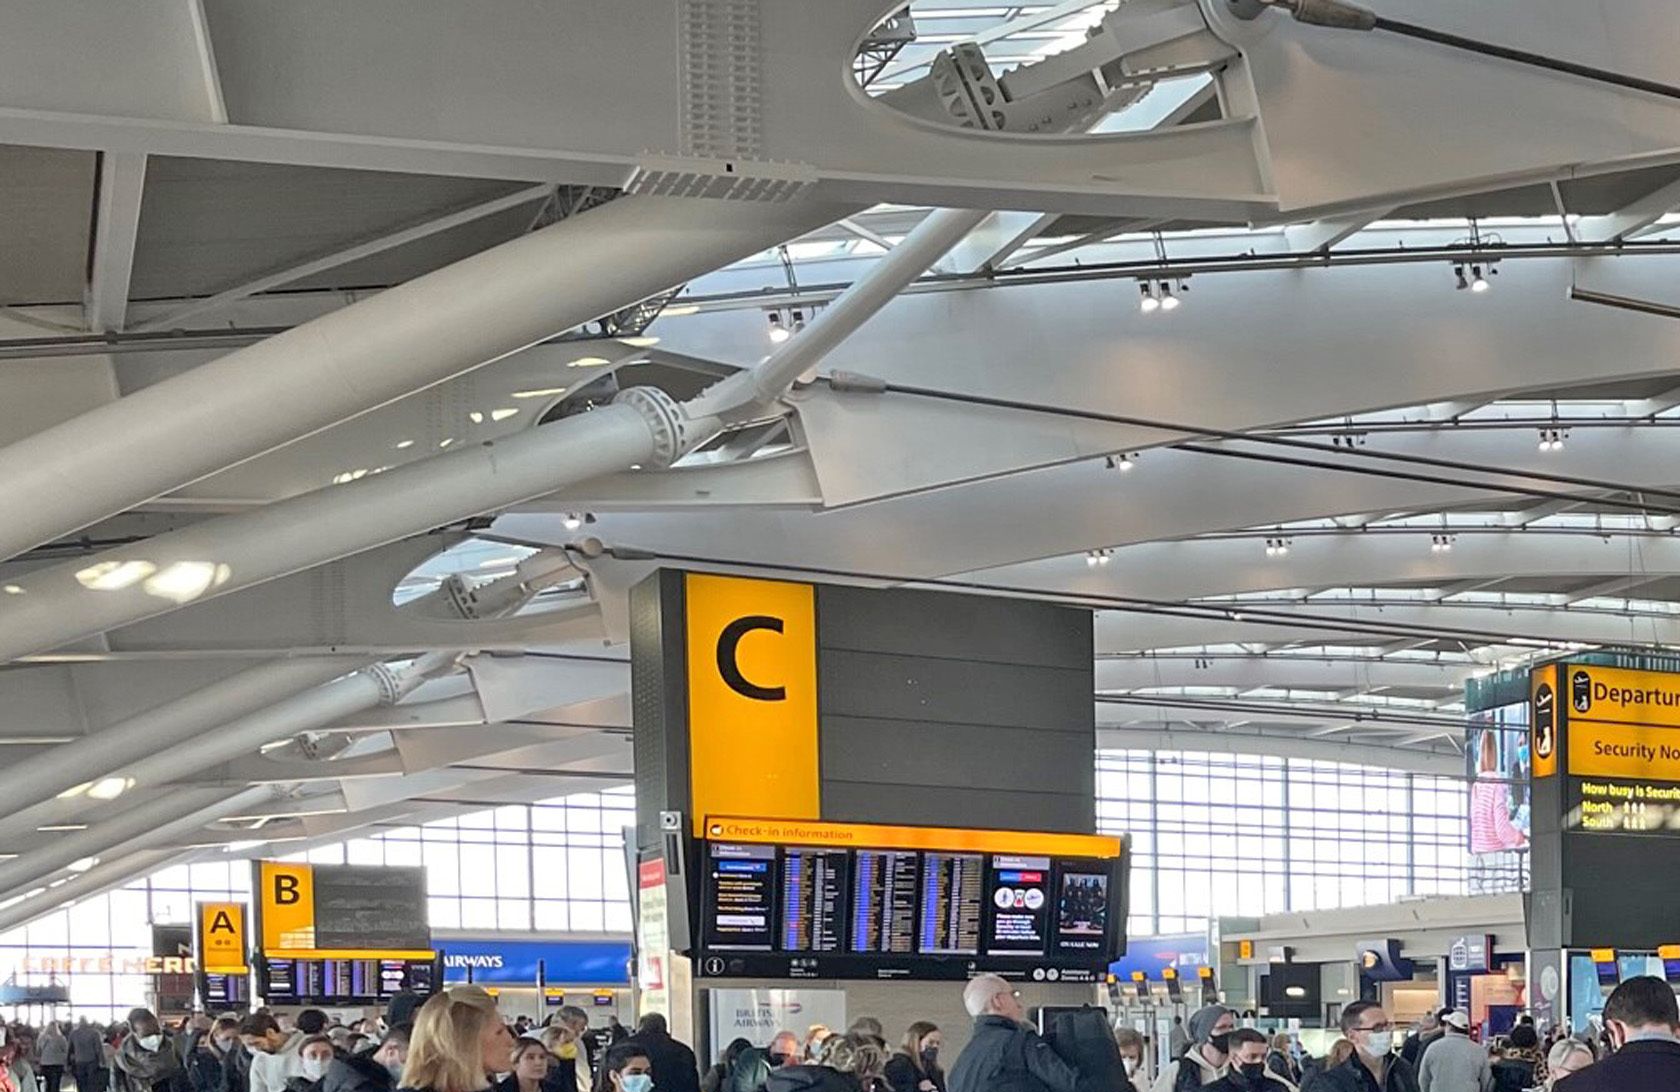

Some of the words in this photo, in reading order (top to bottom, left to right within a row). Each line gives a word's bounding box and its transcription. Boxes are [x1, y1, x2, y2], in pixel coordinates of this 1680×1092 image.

[716, 615, 787, 702] C
[1593, 740, 1656, 762] Security
[1581, 782, 1607, 795] How
[1609, 783, 1634, 799] busy
[1635, 785, 1644, 798] is
[1582, 801, 1613, 813] North
[1582, 816, 1613, 828] South
[727, 824, 780, 838] Check-in
[783, 827, 853, 840] information
[274, 874, 300, 905] B
[210, 911, 236, 934] A
